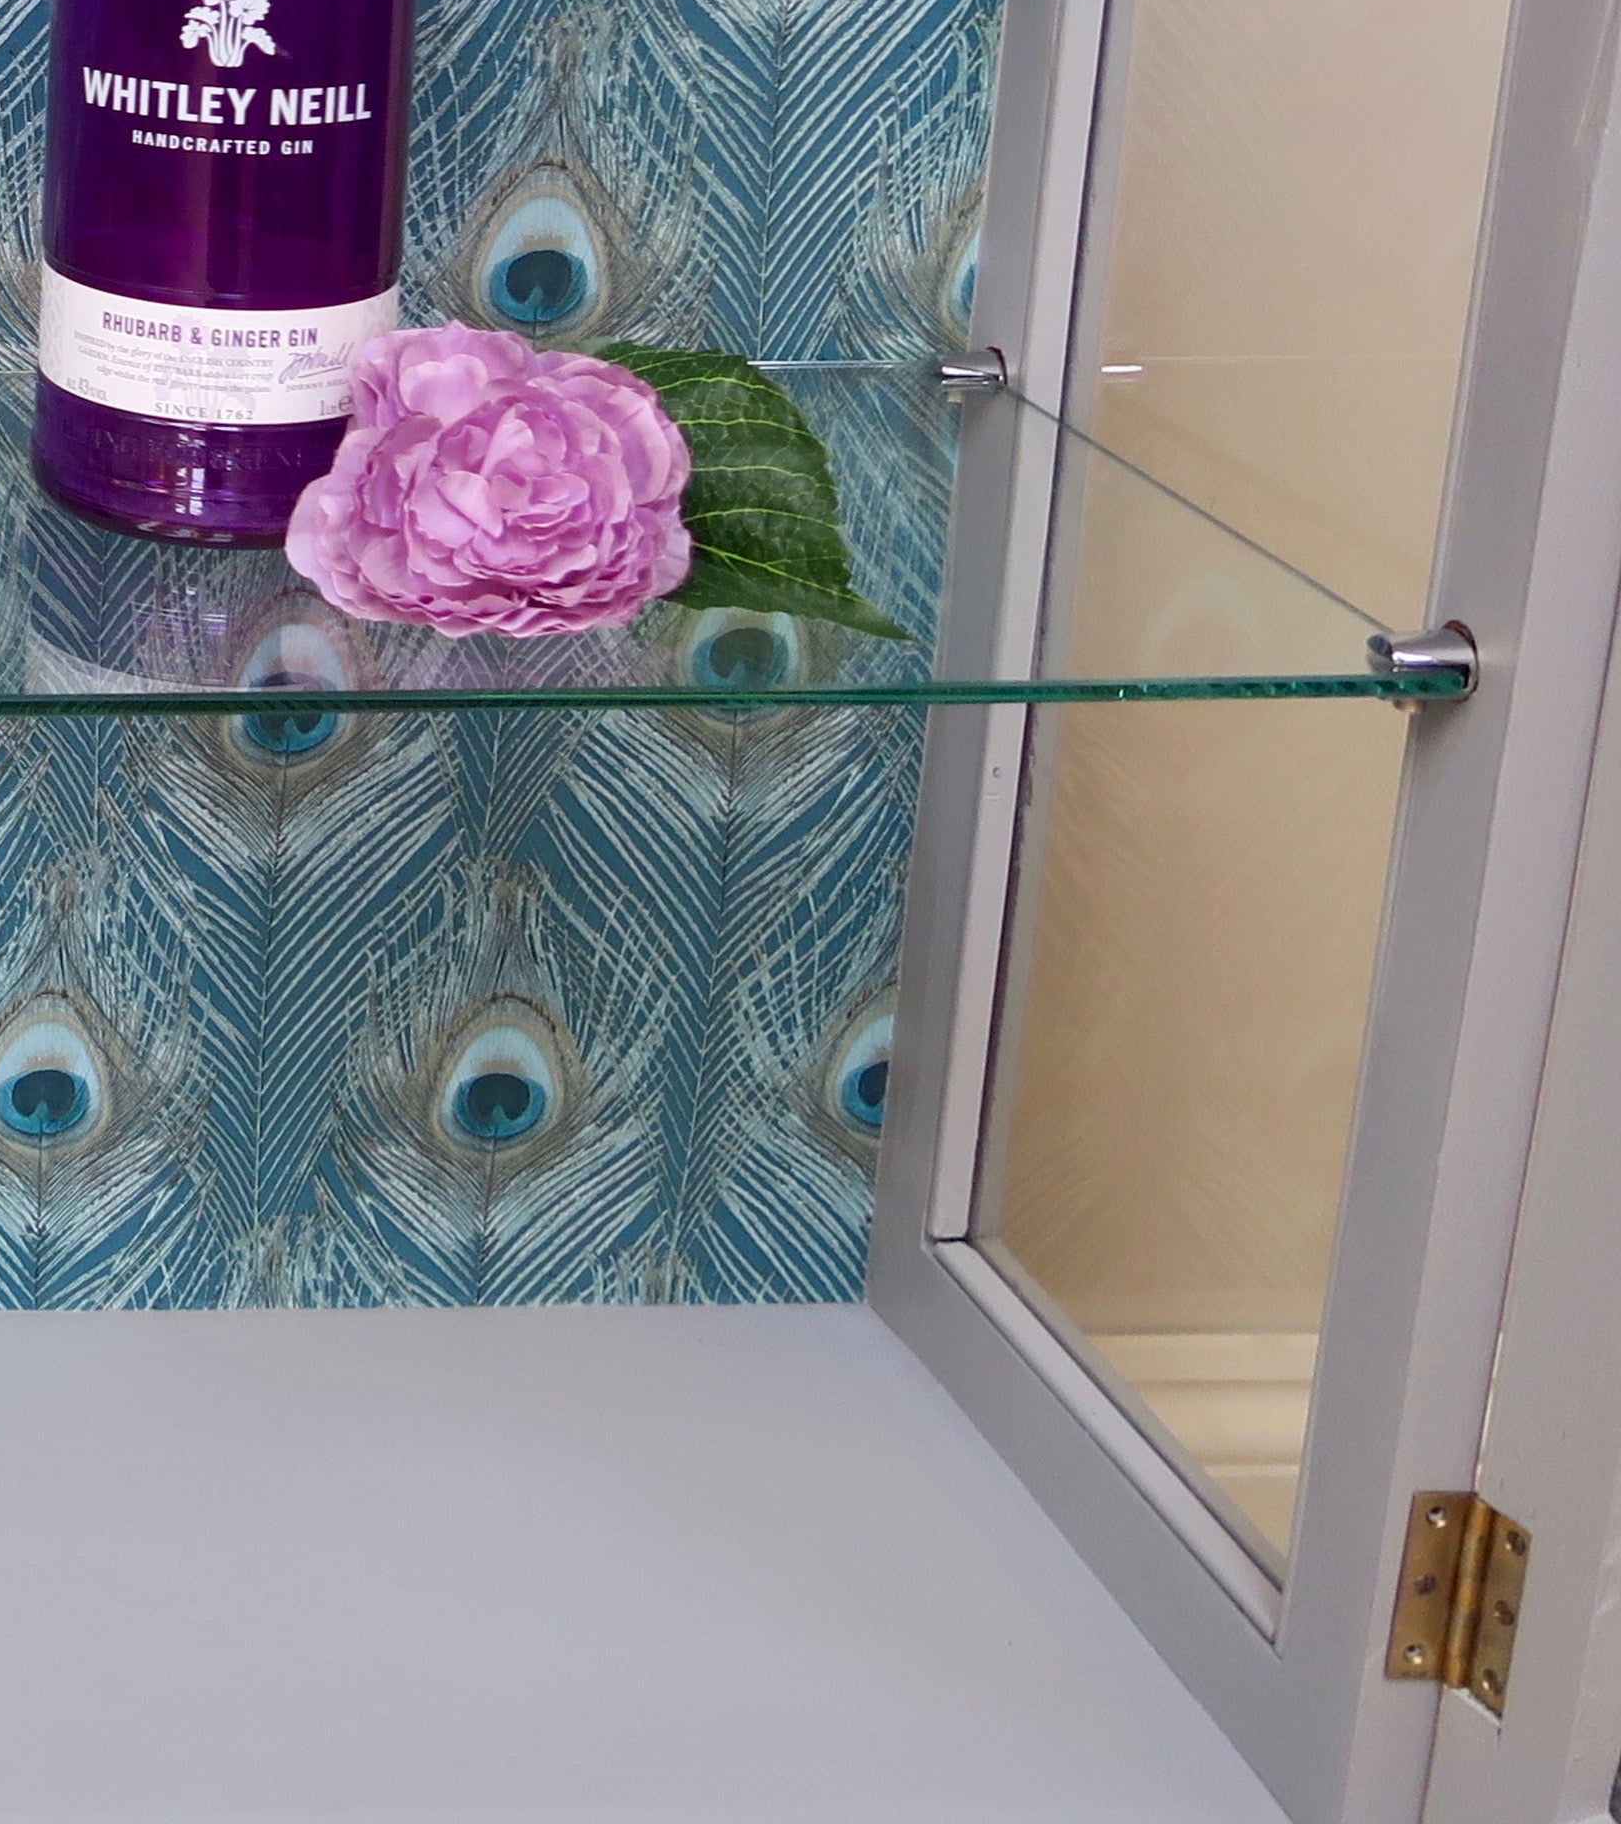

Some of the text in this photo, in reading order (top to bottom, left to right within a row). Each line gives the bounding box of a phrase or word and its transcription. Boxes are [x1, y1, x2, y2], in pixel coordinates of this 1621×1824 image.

[82, 66, 372, 126] WHITLEY NEILL
[131, 129, 314, 155] HANDCRAFTED GIN
[102, 311, 318, 348] RHUBARB & GINGER GIN
[155, 402, 254, 420] SINCE 1762
